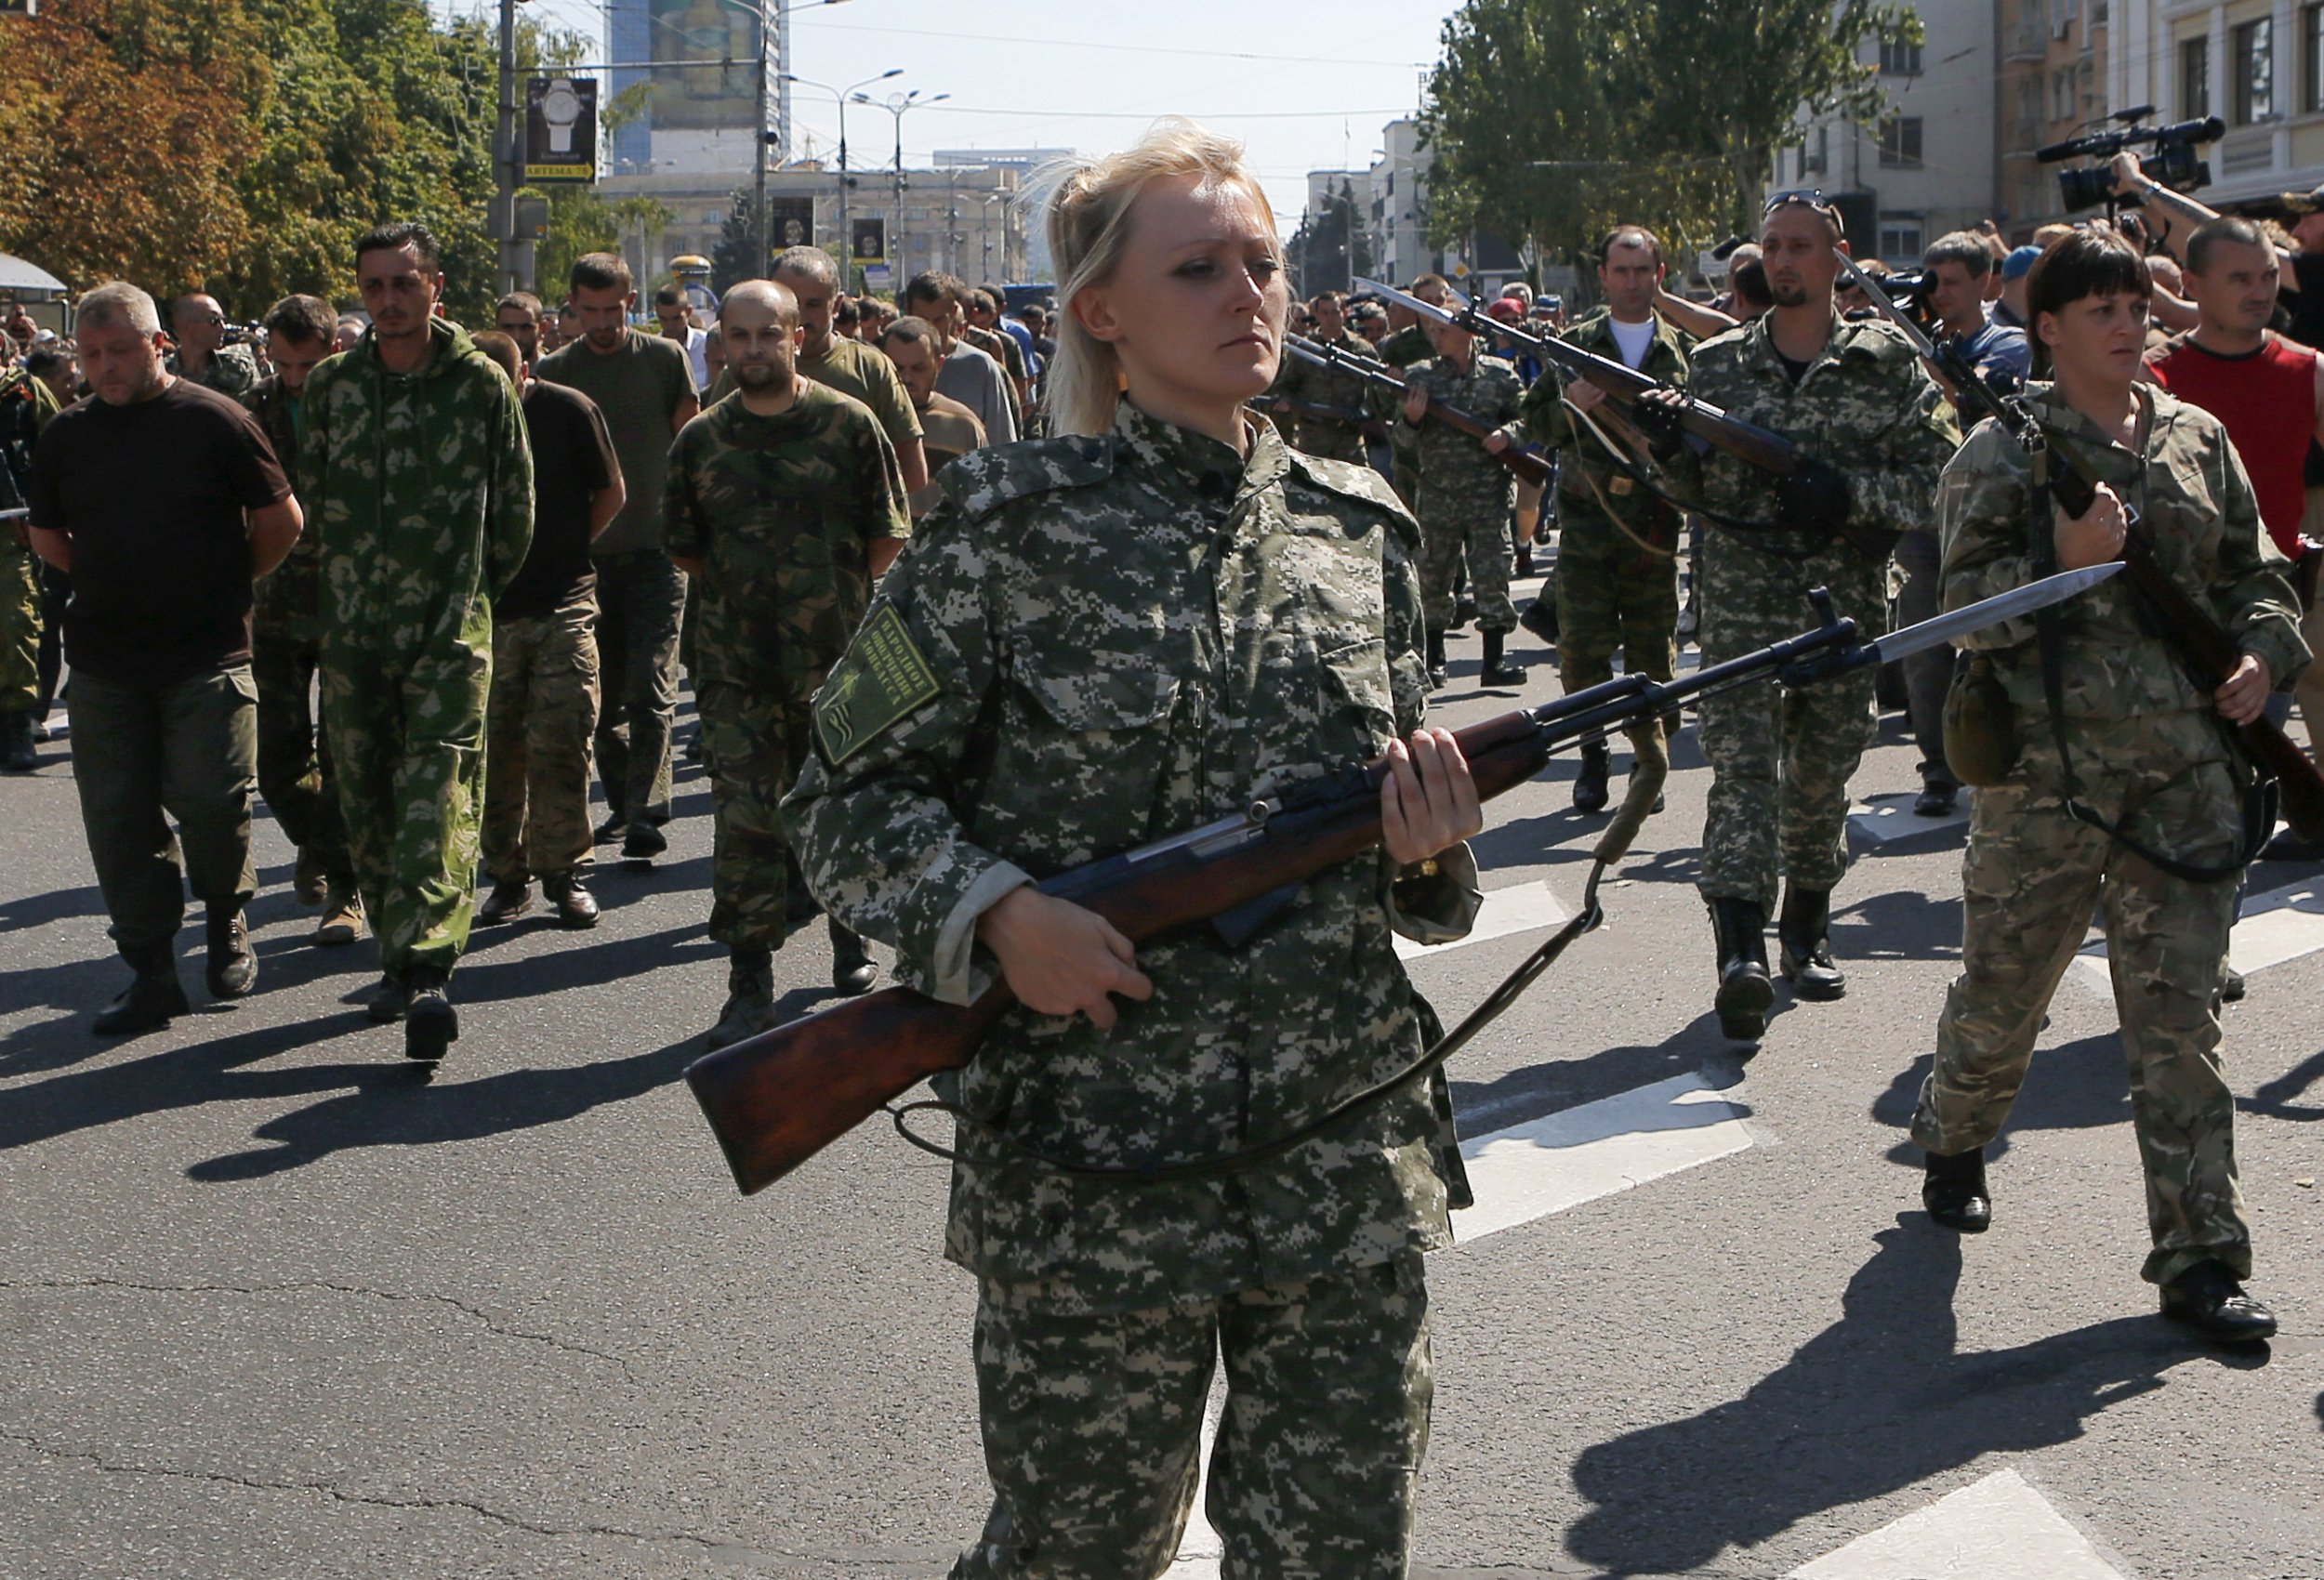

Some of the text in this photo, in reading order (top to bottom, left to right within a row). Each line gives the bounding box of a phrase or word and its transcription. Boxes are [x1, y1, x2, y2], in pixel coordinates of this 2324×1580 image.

[862, 640, 902, 705] ДОНБАССА
[871, 631, 914, 699] ОПОЛЧЕНИЕ
[881, 620, 926, 691] НАРОДНОЕ
